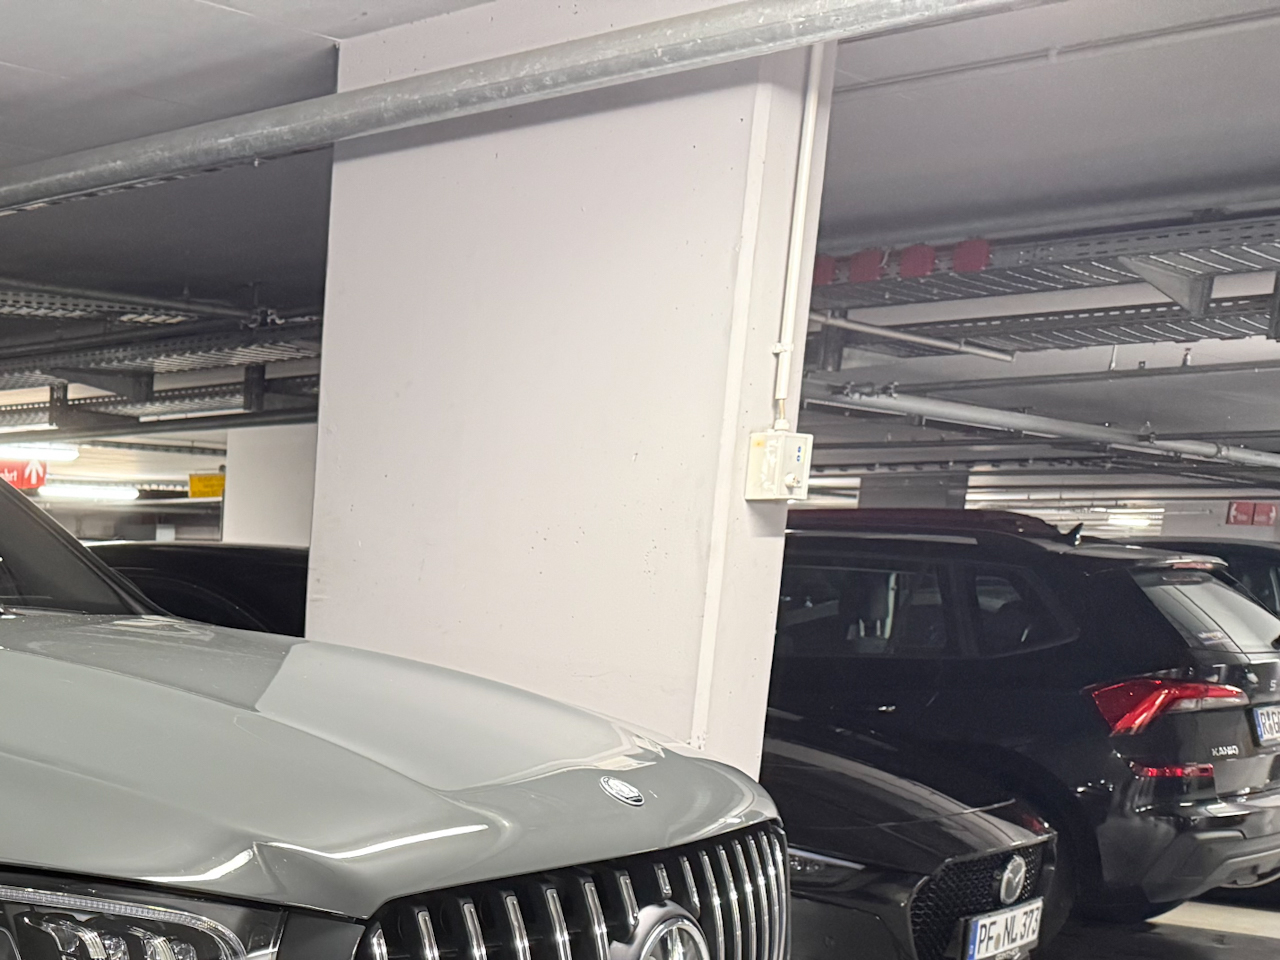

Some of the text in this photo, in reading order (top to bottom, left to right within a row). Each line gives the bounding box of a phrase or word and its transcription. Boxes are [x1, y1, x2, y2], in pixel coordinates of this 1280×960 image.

[977, 920, 997, 955] PF
[1002, 914, 1018, 948] NL
[1019, 906, 1041, 941] 373
